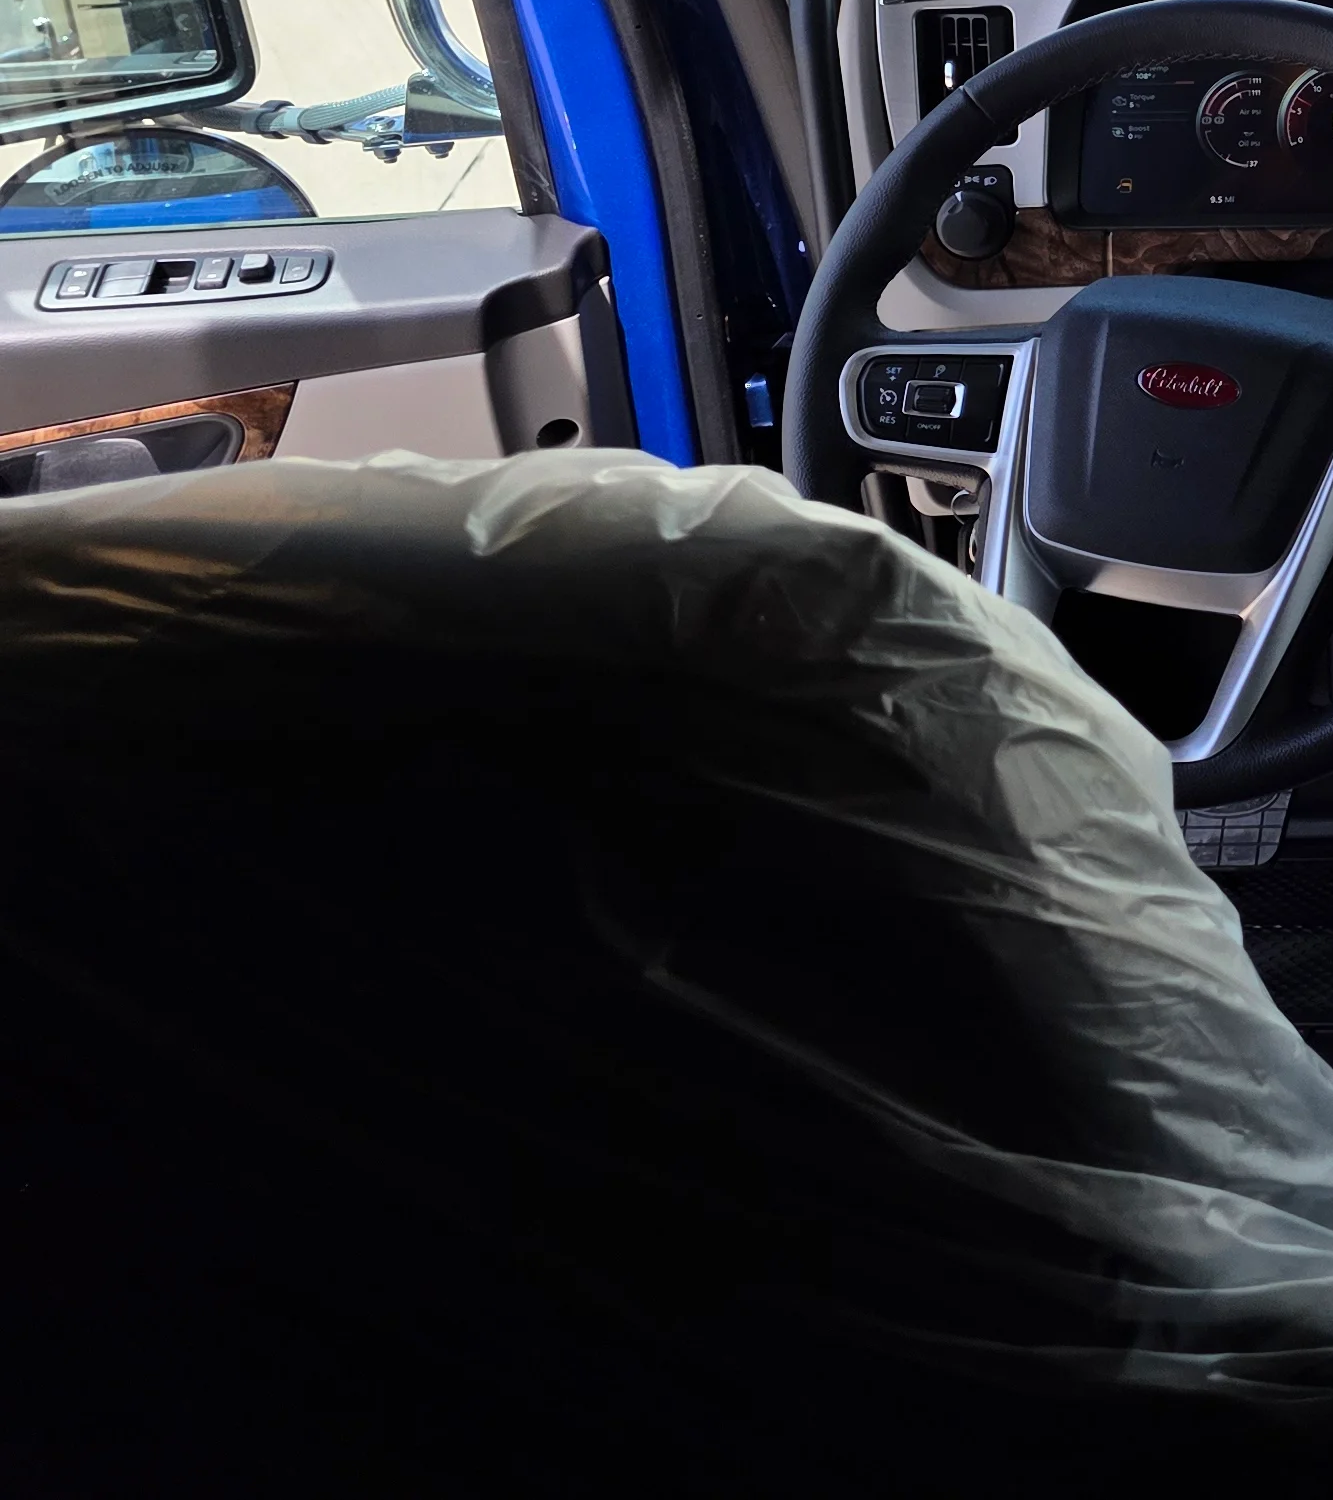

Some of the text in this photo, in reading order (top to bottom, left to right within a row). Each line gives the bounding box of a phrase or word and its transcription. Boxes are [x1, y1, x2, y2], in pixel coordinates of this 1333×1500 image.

[1129, 93, 1156, 102] Torque
[1239, 108, 1249, 116] Air
[1237, 139, 1249, 148] Oil
[53, 162, 179, 197] LOOSEN TO ADJUST
[885, 366, 903, 374] SET
[1147, 367, 1226, 398] Peterbilt
[879, 415, 897, 425] RES
